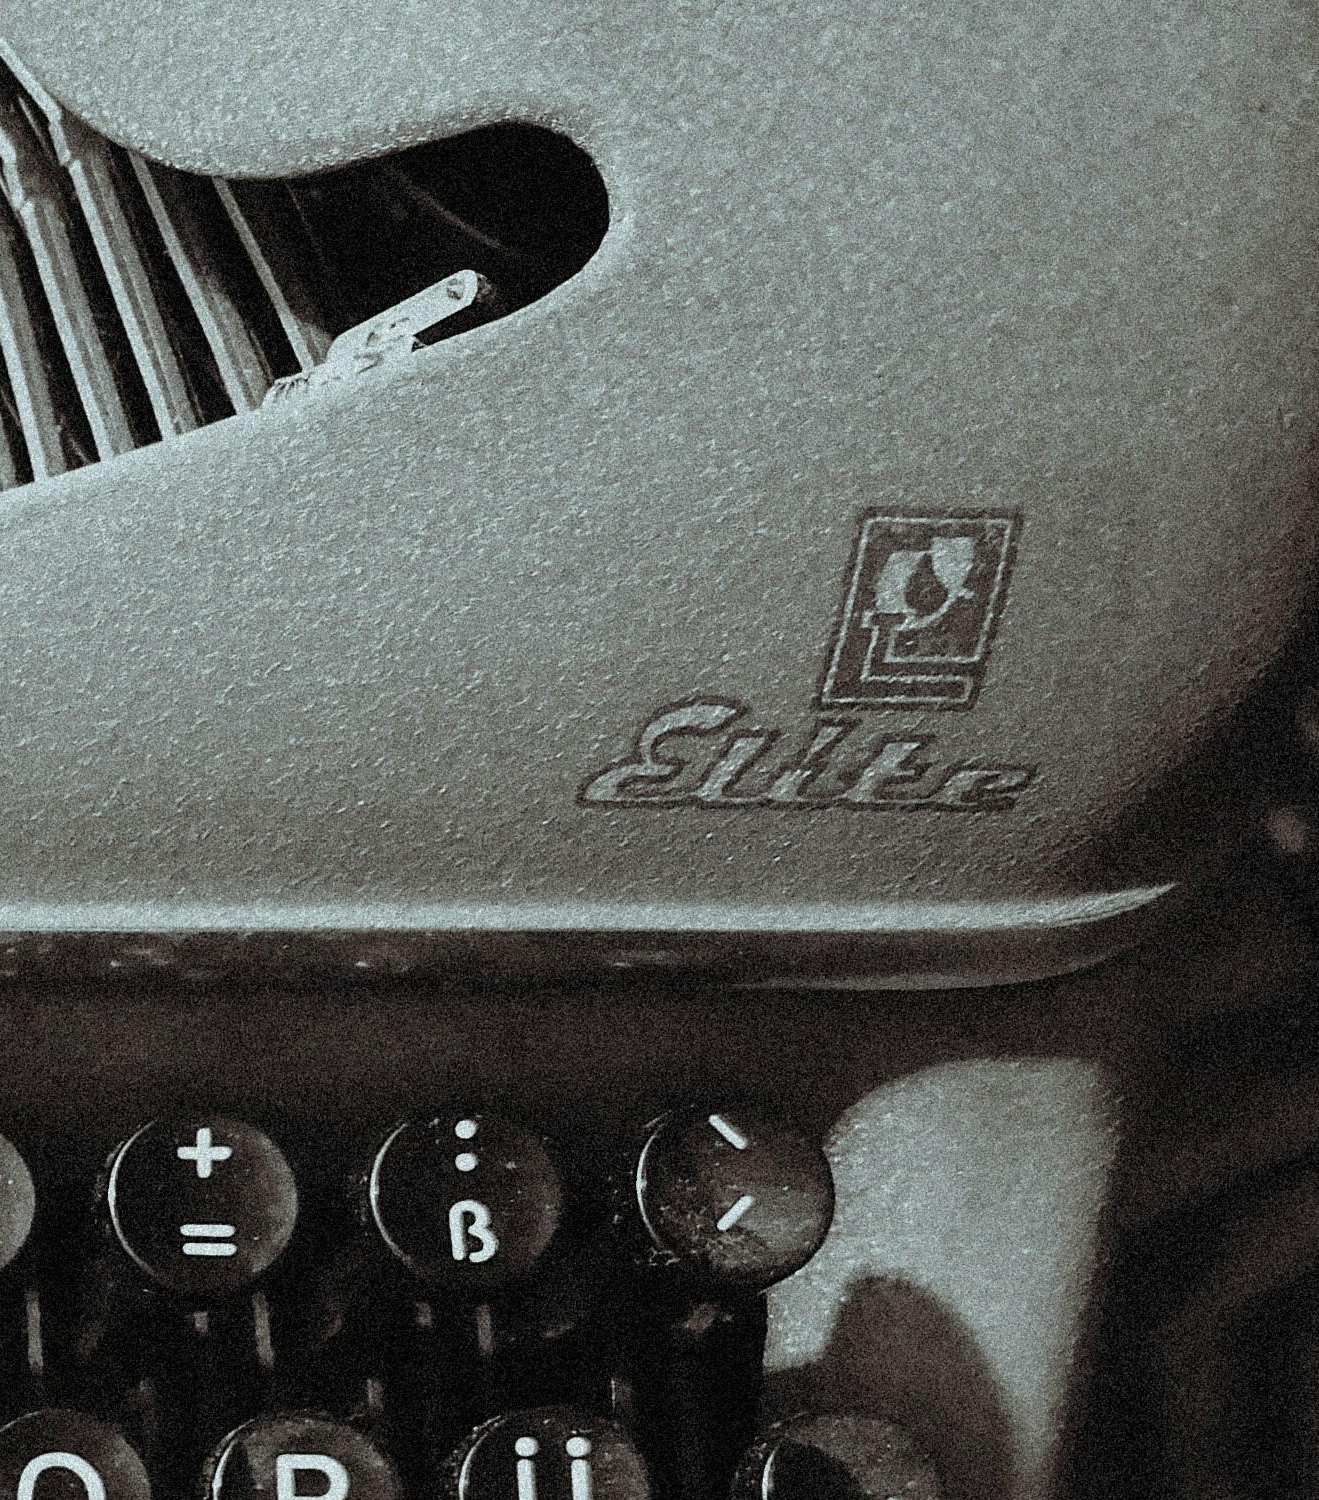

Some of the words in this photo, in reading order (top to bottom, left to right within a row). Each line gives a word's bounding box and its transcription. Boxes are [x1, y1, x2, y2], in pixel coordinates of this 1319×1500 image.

[576, 697, 1039, 812] Elite
[177, 1128, 232, 1178] +
[455, 1120, 477, 1172] :
[180, 1224, 237, 1256] =
